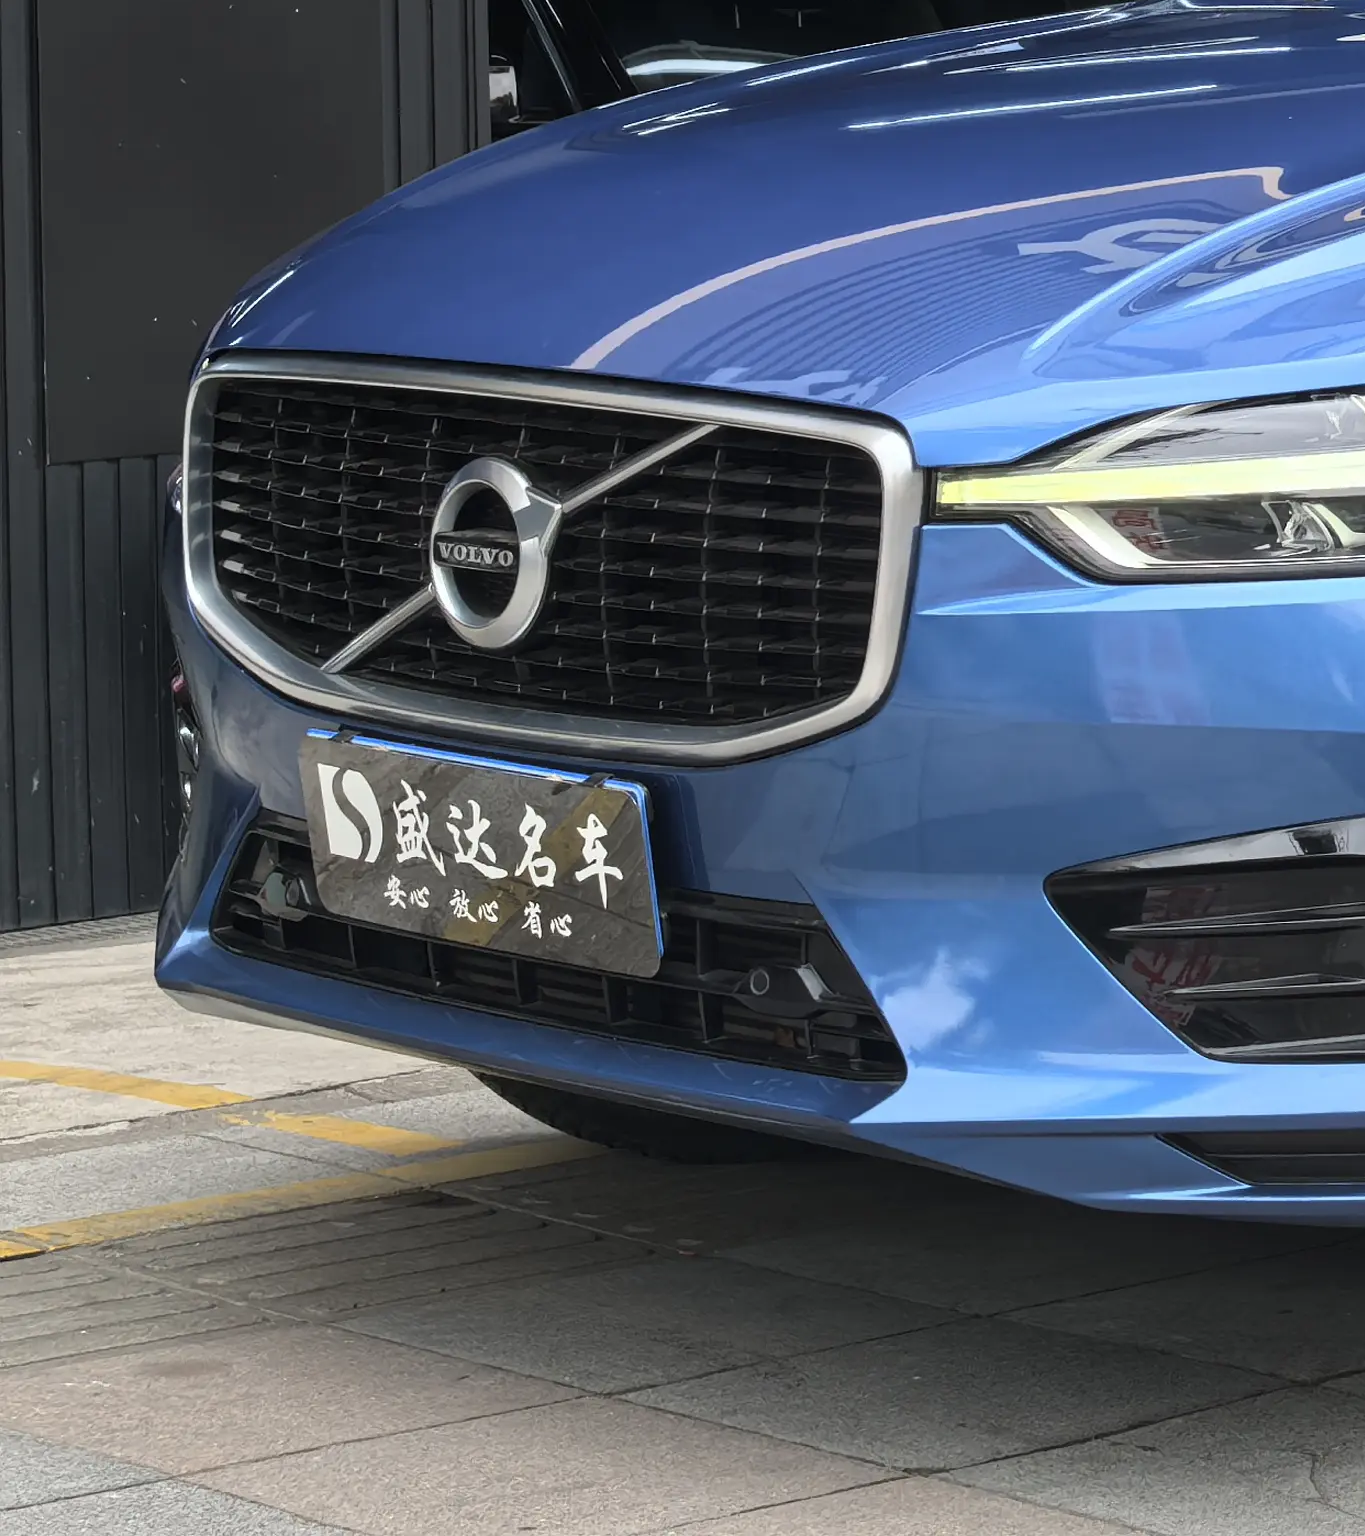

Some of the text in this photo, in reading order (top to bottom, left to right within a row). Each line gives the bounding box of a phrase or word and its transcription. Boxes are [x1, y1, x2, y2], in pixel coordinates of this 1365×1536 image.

[437, 542, 513, 566] VOLVO
[391, 779, 624, 909] 盛达名车
[384, 874, 430, 909] 安心
